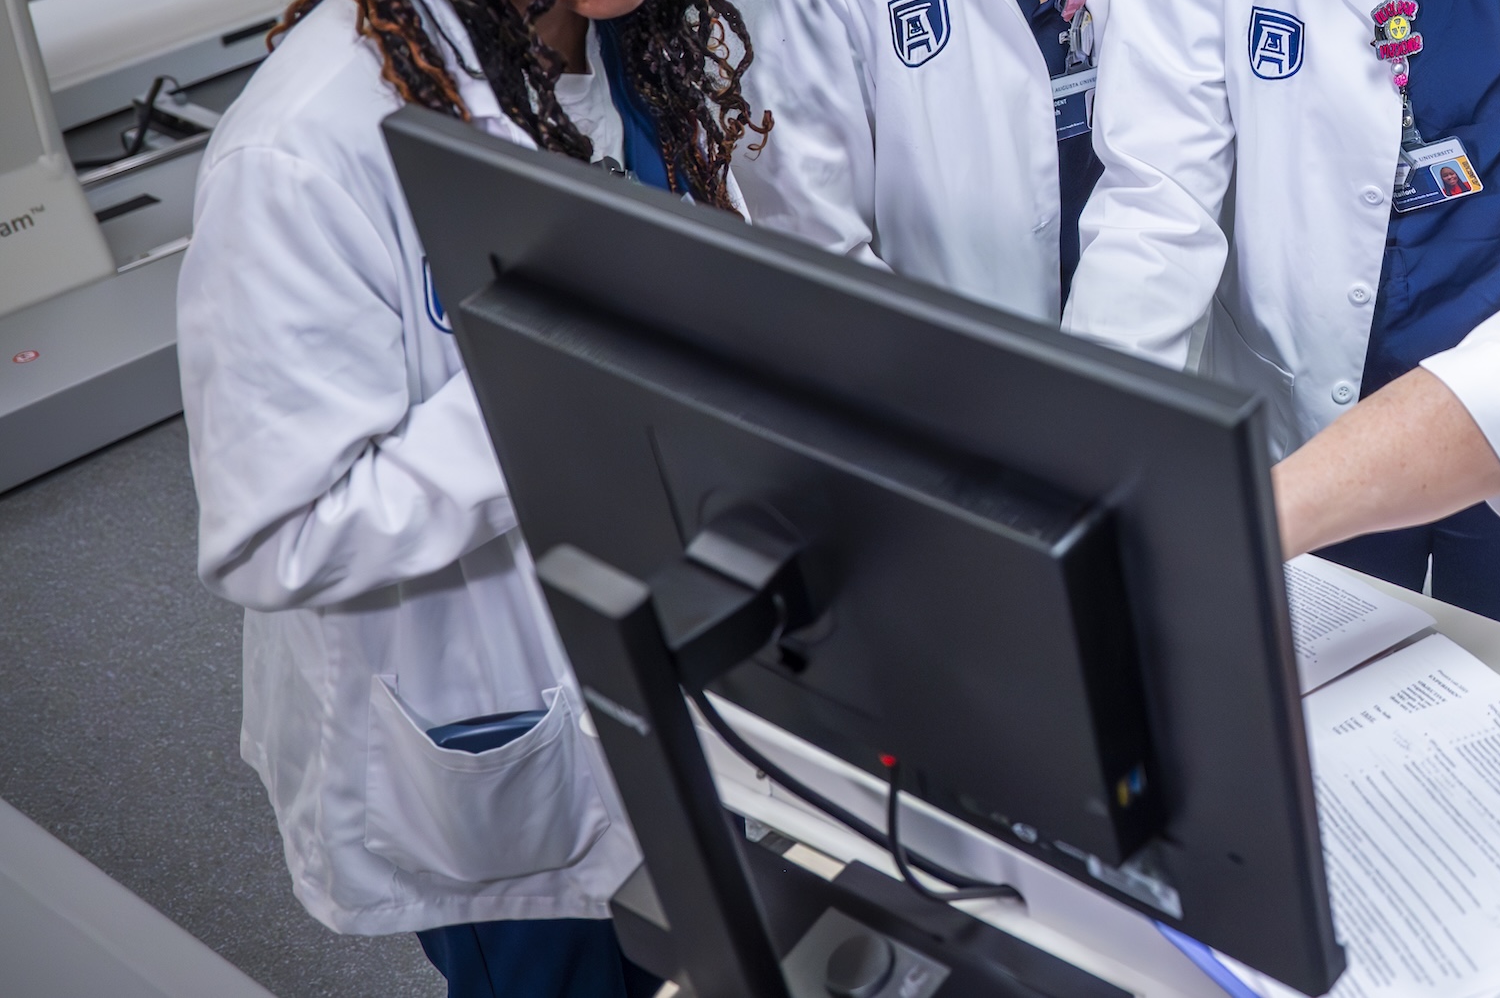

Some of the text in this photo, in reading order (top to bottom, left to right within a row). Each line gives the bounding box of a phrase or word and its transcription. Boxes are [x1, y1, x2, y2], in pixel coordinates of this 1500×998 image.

[1374, 0, 1417, 25] NUCLEAR
[1380, 35, 1421, 59] MEDICINE
[1055, 82, 1079, 93] AUGUSTA
[1418, 148, 1455, 162] UNIVERSITY
